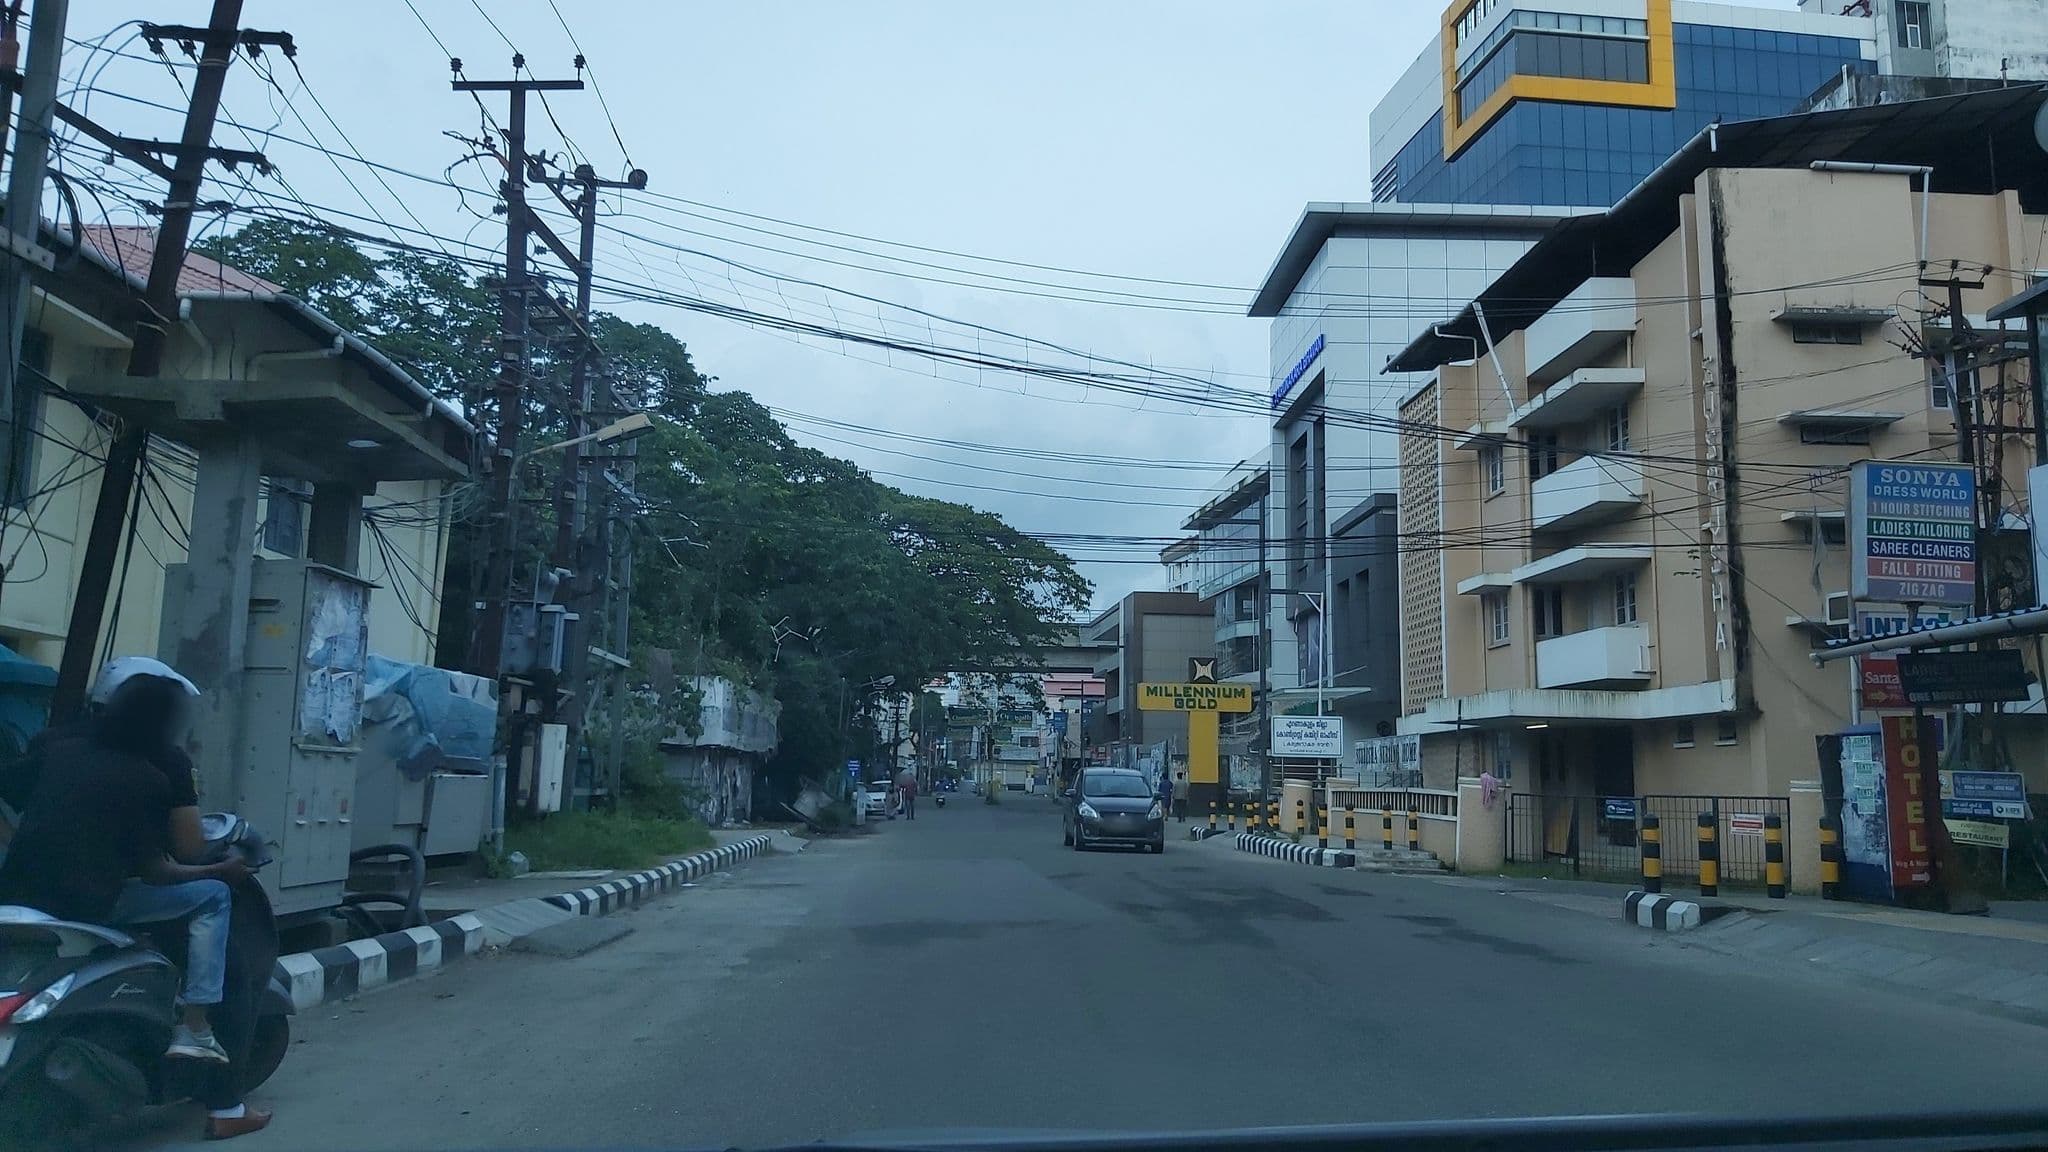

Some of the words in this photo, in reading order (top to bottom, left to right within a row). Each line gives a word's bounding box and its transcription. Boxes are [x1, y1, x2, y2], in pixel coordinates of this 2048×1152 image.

[1881, 469, 1960, 486] SONYA
[1874, 484, 1917, 498] DRESS
[1921, 486, 1967, 500] WORLD
[1872, 502, 1877, 513] 1
[1881, 502, 1910, 515] HOUR
[1913, 504, 1970, 519] STITCHING
[1873, 520, 1912, 536] LADIES
[1913, 522, 1970, 539] TAILORING
[1872, 541, 1909, 555] SAREE
[1912, 543, 1971, 559] CLEANERS
[1881, 562, 1909, 576] FALL
[1916, 563, 1961, 578] FITTING
[1899, 582, 1919, 595] ZIG
[1921, 583, 1945, 597] ZAG
[1146, 685, 1246, 698] MILLENNIUM
[1174, 698, 1218, 709] GOLD
[1899, 716, 1928, 852] HOTEL
